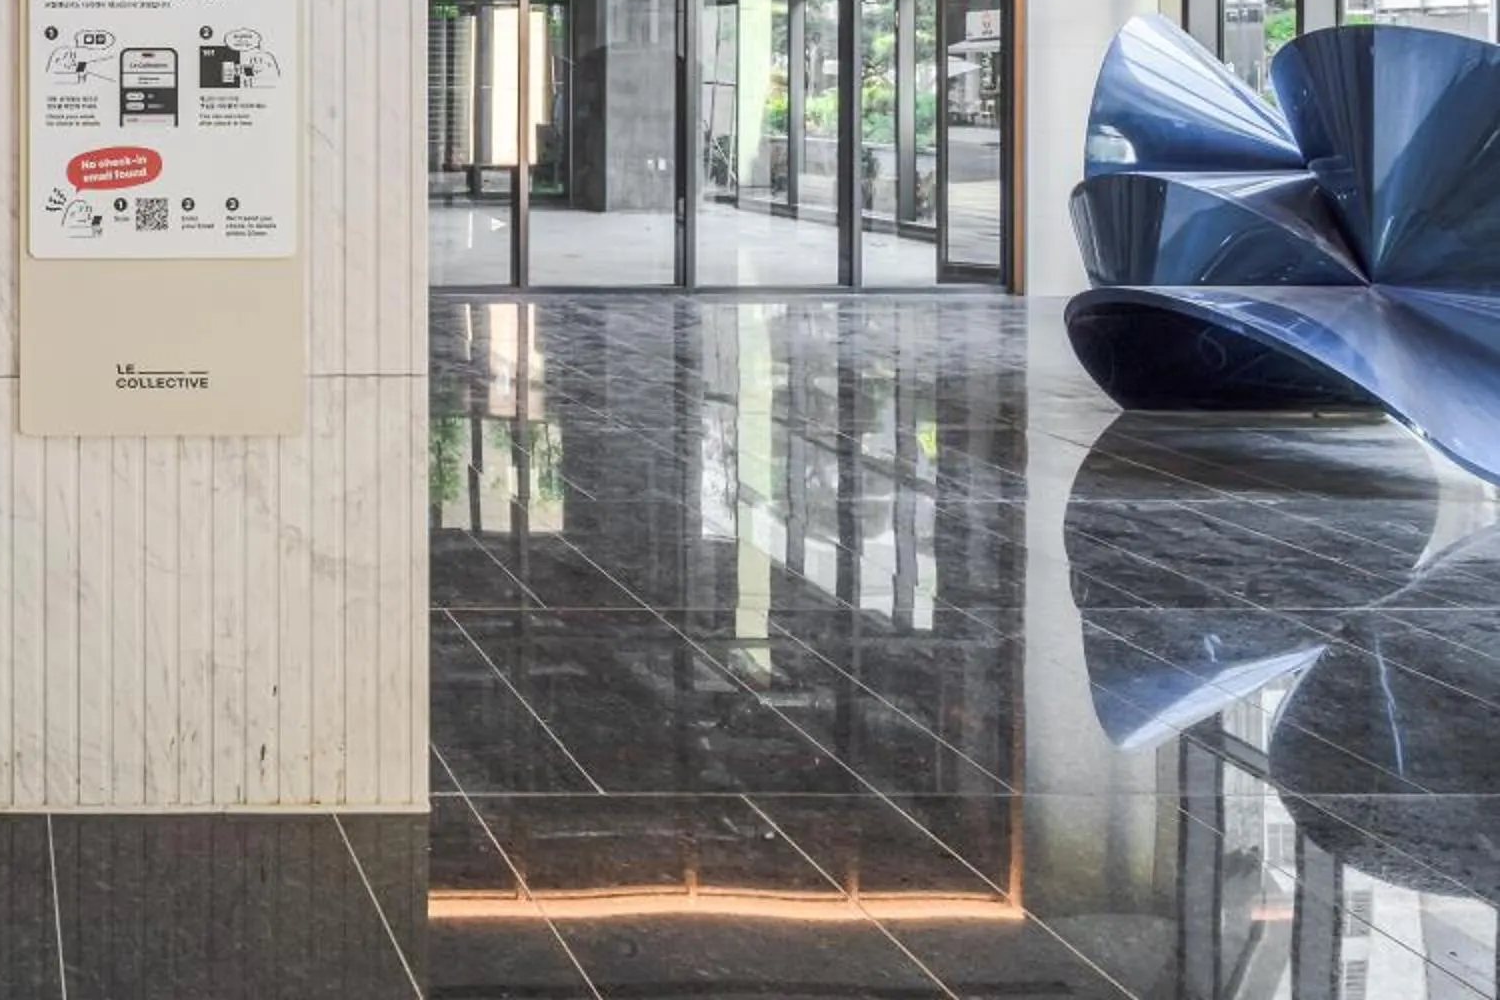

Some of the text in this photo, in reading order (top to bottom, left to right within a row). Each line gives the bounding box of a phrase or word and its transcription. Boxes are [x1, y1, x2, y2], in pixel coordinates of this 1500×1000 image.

[98, 154, 148, 168] check-in
[116, 363, 135, 375] LE
[116, 377, 209, 389] COLLECTIVE
